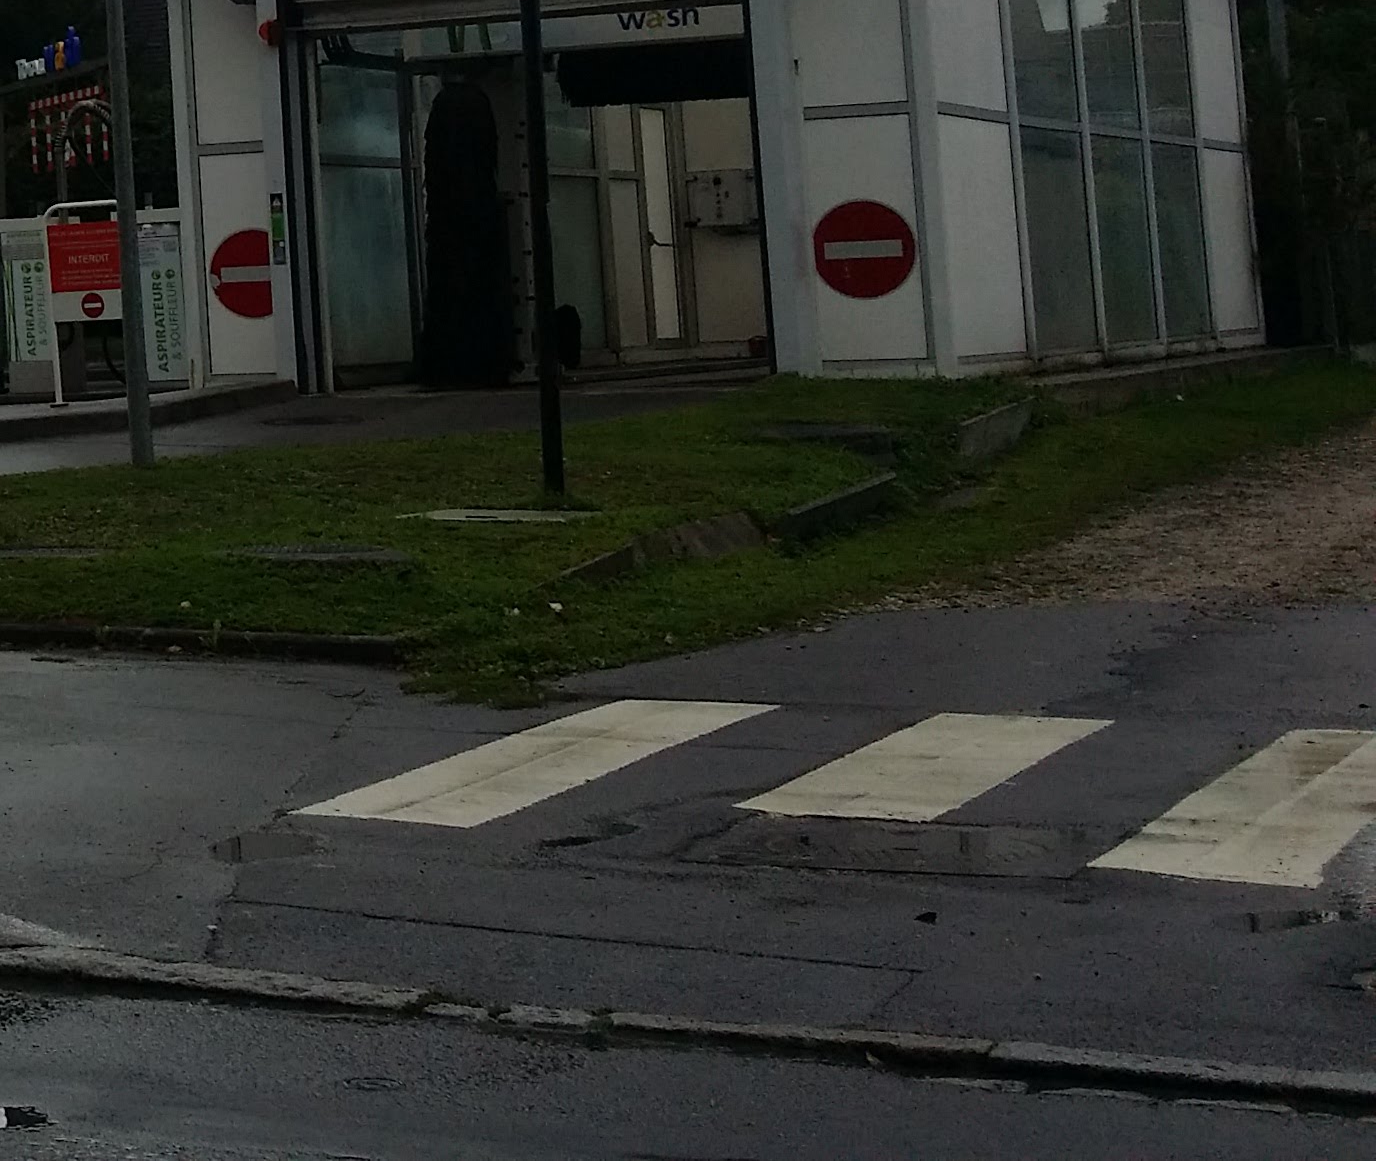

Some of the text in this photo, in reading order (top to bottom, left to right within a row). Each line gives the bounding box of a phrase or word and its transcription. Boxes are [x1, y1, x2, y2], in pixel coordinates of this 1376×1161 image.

[68, 253, 110, 264] INTERDIT
[21, 276, 36, 356] ASPIRATEUR
[152, 281, 169, 372] ASPIRATEUR
